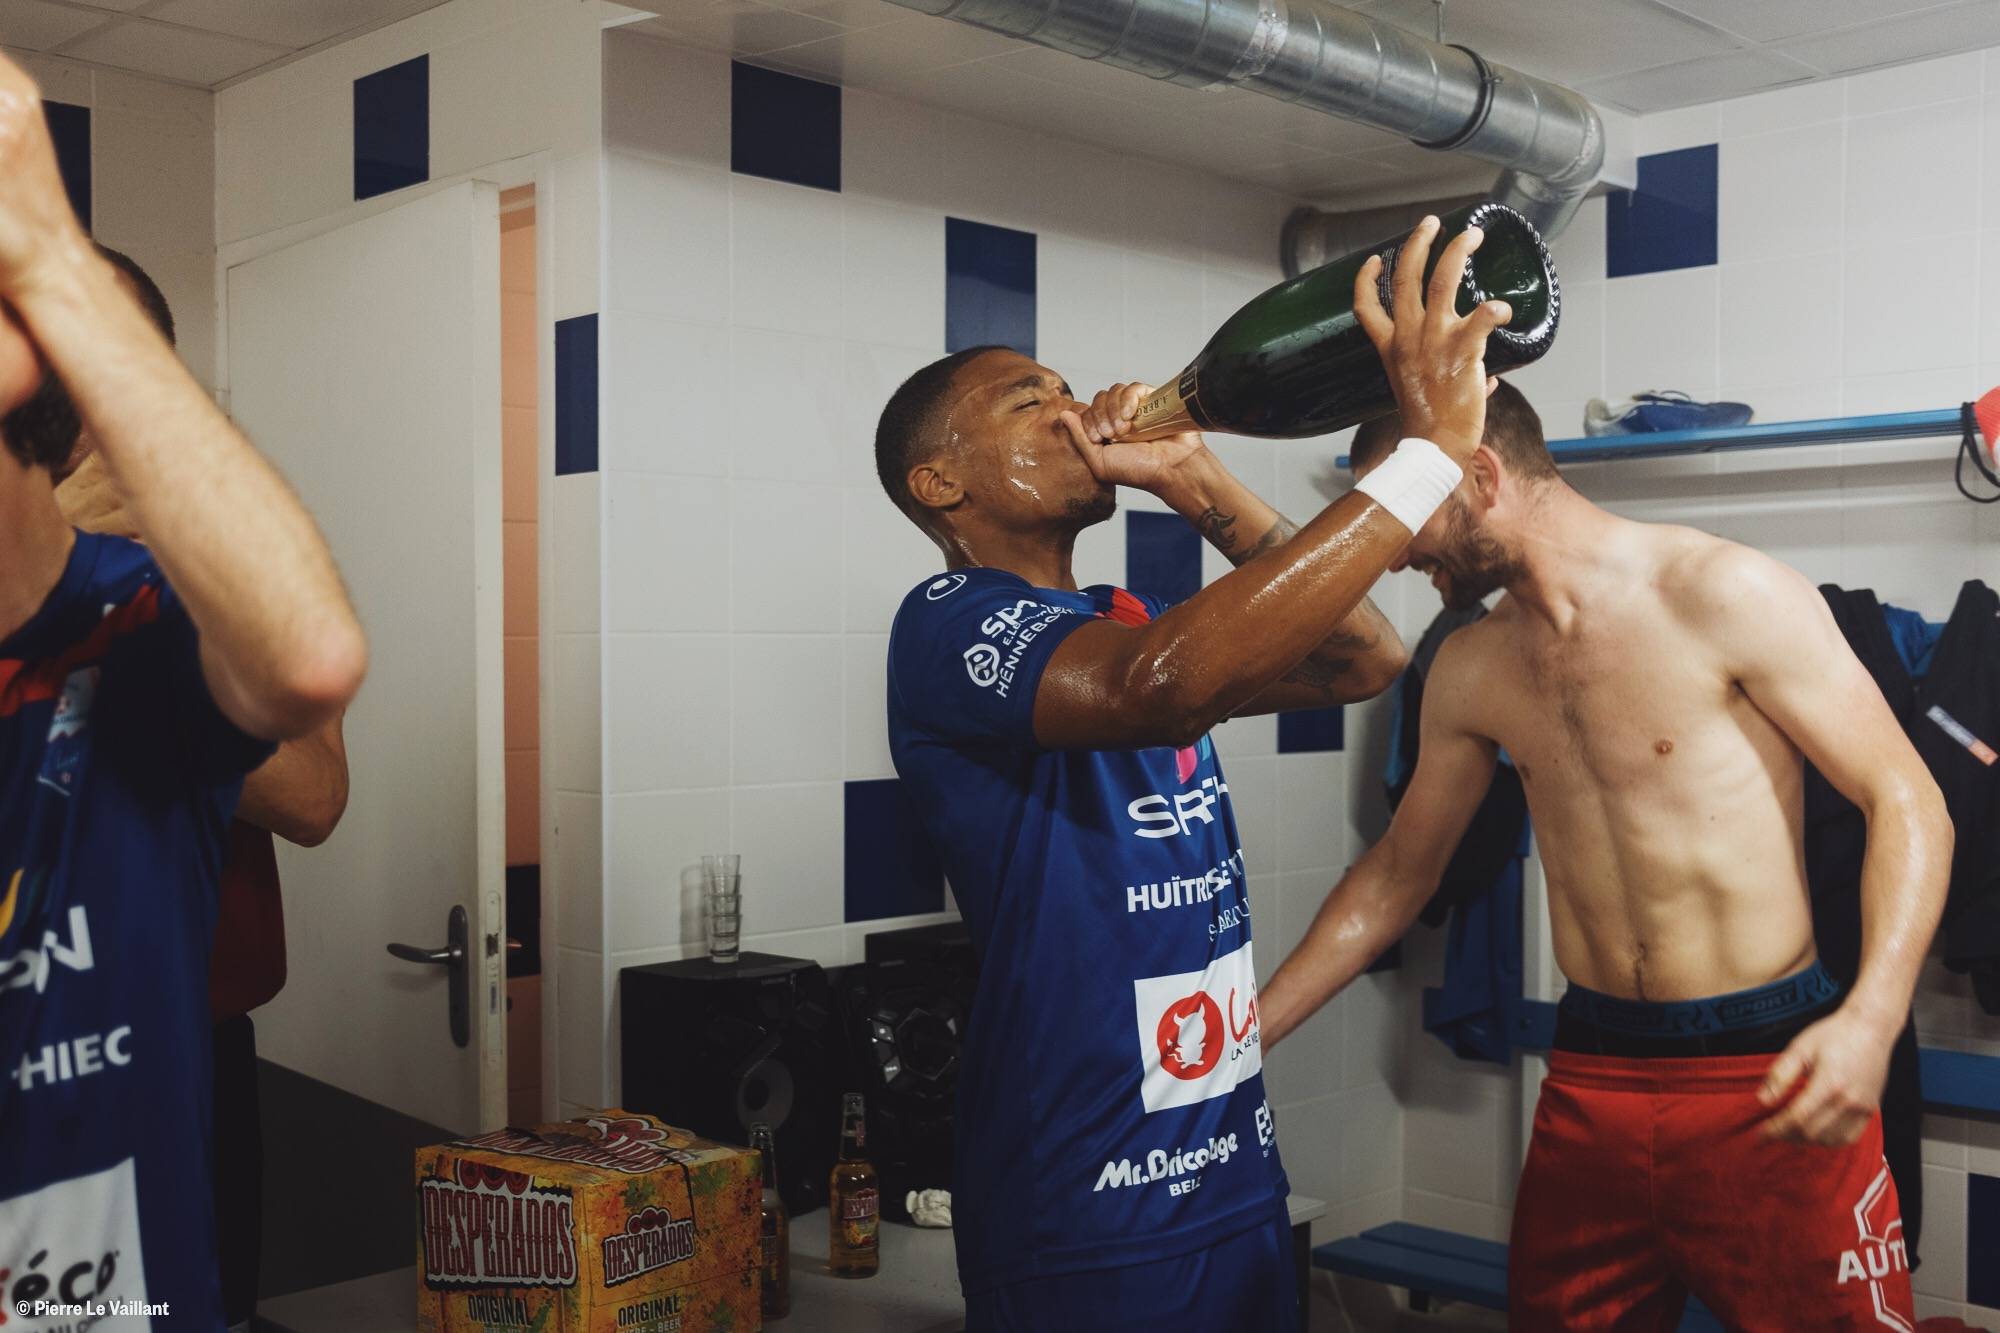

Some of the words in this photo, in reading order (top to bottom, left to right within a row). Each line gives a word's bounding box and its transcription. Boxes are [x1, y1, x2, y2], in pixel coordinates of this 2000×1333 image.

[424, 1185, 575, 1279] DESPERADOS
[604, 1220, 695, 1283] DESPERADOS
[468, 1294, 532, 1328] ORIGINAL
[617, 1294, 682, 1328] ORIGINAL
